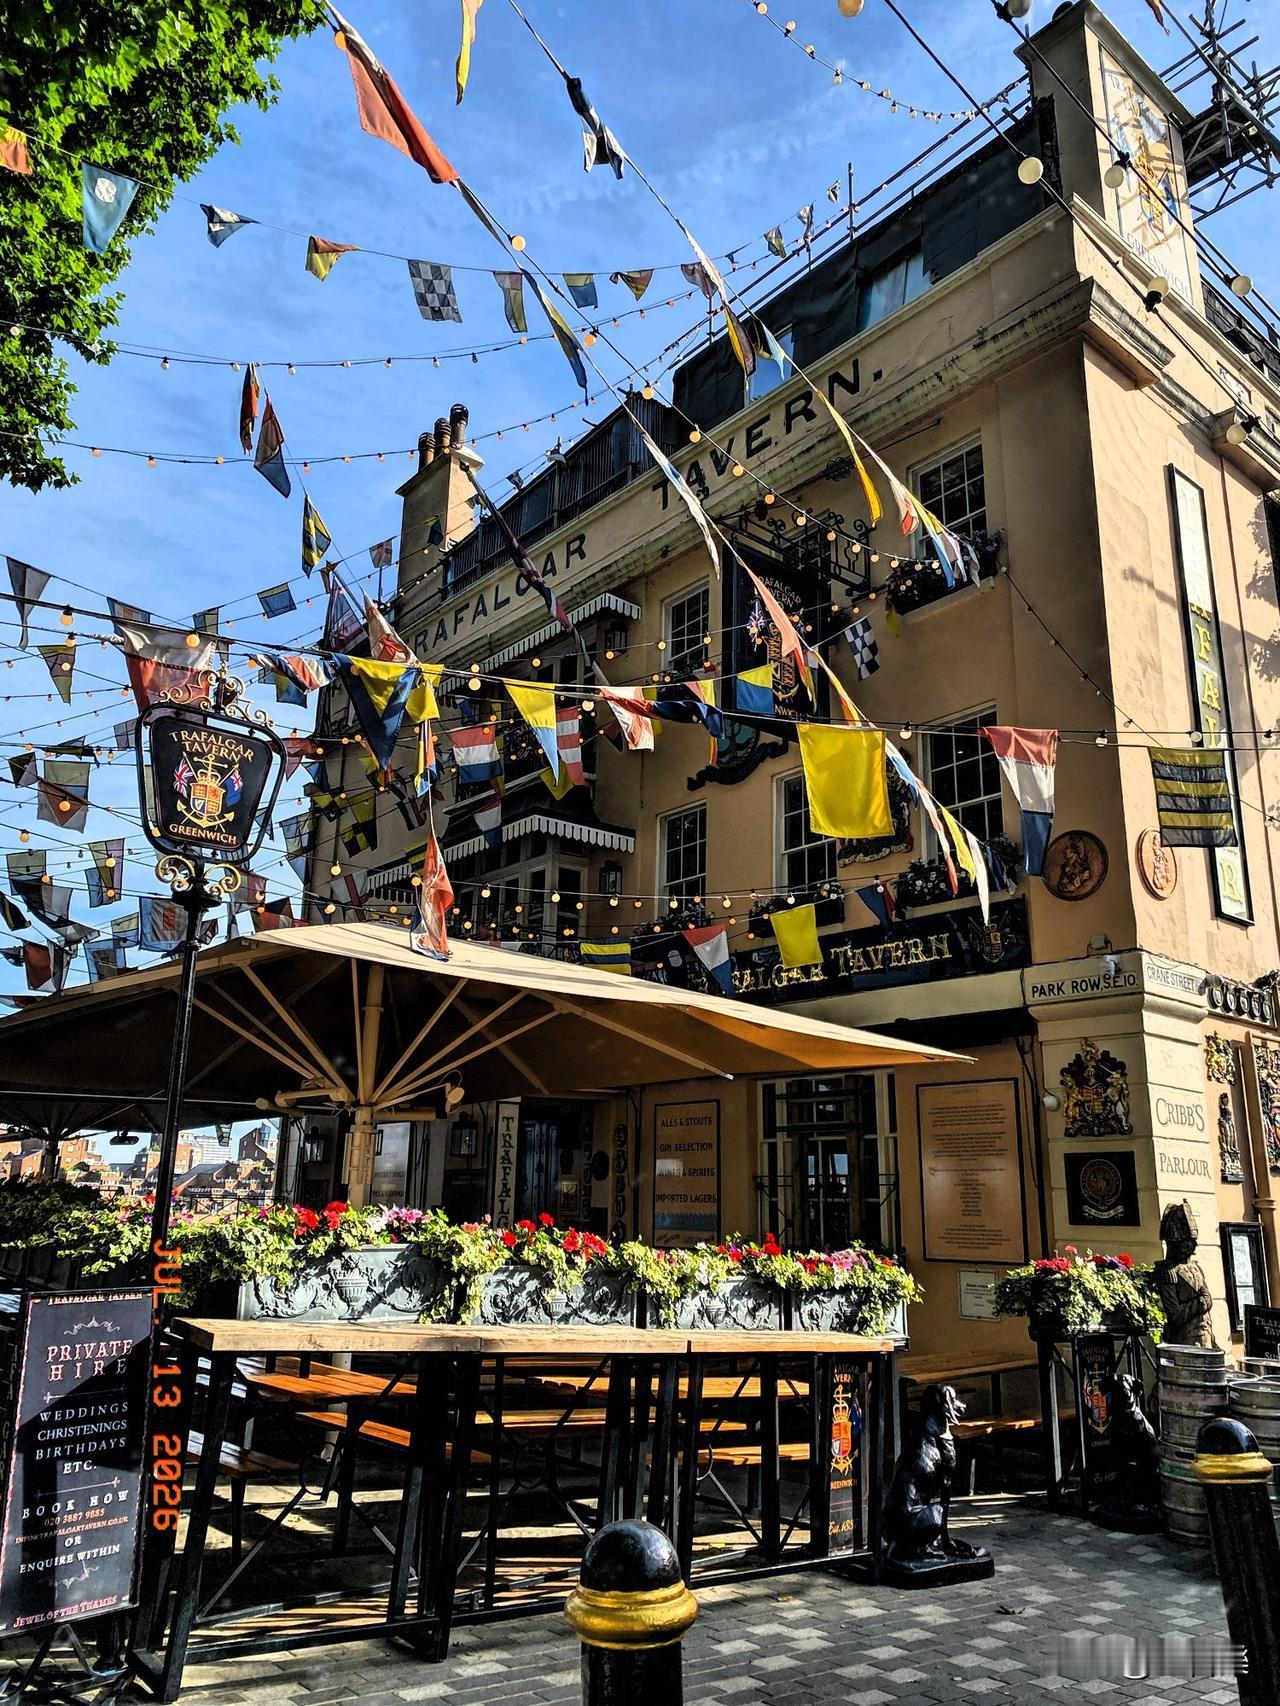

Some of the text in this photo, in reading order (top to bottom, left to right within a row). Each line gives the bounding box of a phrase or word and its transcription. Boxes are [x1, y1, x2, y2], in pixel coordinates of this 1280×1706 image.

[404, 358, 883, 655] RAFALGAR TAVERN.
[169, 730, 254, 762] TRAFALGAR
[182, 741, 242, 763] TAVERN
[169, 823, 237, 845] GREENWICH
[831, 932, 953, 977] TAVERN
[1032, 981, 1066, 998] PARK
[1146, 965, 1170, 985] CRANE
[1170, 972, 1194, 992] STREET
[660, 1118, 678, 1128] ALES
[685, 1116, 713, 1126] STOUTS
[1156, 1097, 1206, 1132] CRIBB'S
[660, 1142, 713, 1152] GIN SELECTION
[499, 1116, 516, 1230] TRAFALG
[687, 1167, 715, 1177] SPIRITS
[1159, 1152, 1212, 1180] PARLOUR
[656, 1193, 717, 1204] IMPORTED LAGERS
[46, 1339, 133, 1363] PRIVATE
[48, 1358, 127, 1382] HIRE
[40, 1401, 129, 1422] WEDDINGS
[38, 1419, 127, 1442] CHRISTENINGS
[35, 1437, 126, 1460] BIRTHDAYS
[62, 1459, 97, 1475] ETC.
[22, 1499, 76, 1520] BOOK
[44, 1516, 61, 1527] 020
[63, 1511, 84, 1524] 3887
[65, 1535, 82, 1548] OR
[20, 1543, 120, 1574] ENQUIRE WITHIN
[13, 1595, 118, 1629] JEWEL OF THE THAMES
